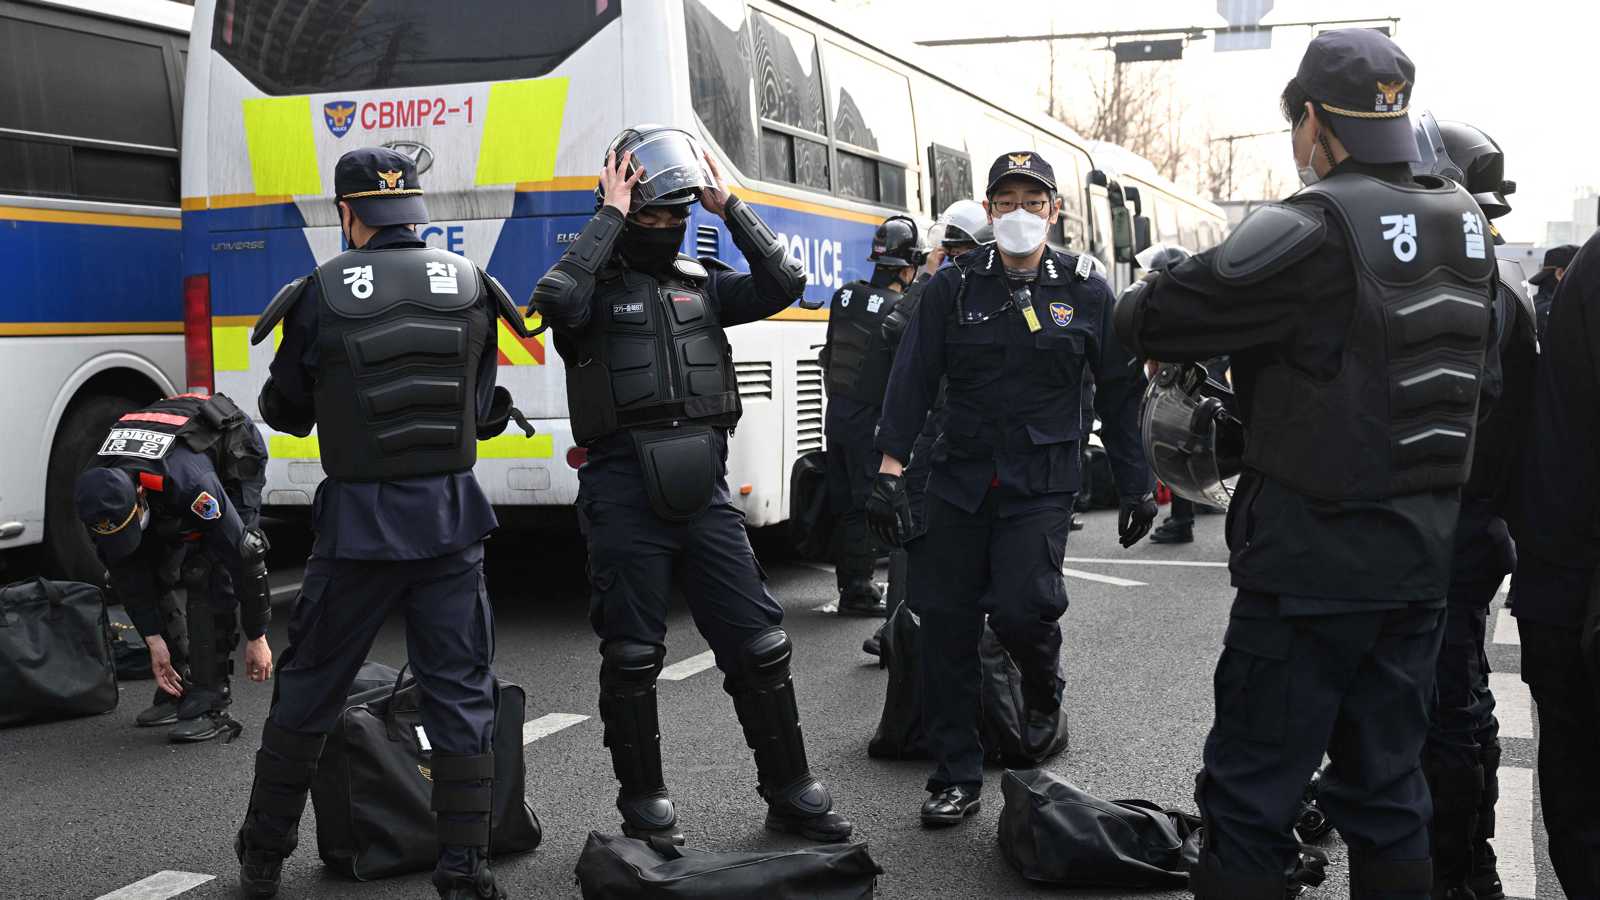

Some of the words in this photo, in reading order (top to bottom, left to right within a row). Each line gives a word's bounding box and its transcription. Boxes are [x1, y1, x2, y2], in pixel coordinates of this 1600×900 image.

[360, 97, 474, 130] CBMP2-1
[1380, 214, 1418, 262] 경
[1462, 211, 1486, 259] 찰
[342, 265, 374, 299] 경
[425, 261, 458, 294] 찰
[841, 289, 853, 307] 경
[867, 294, 884, 313] 찰
[117, 431, 164, 442] POLICE
